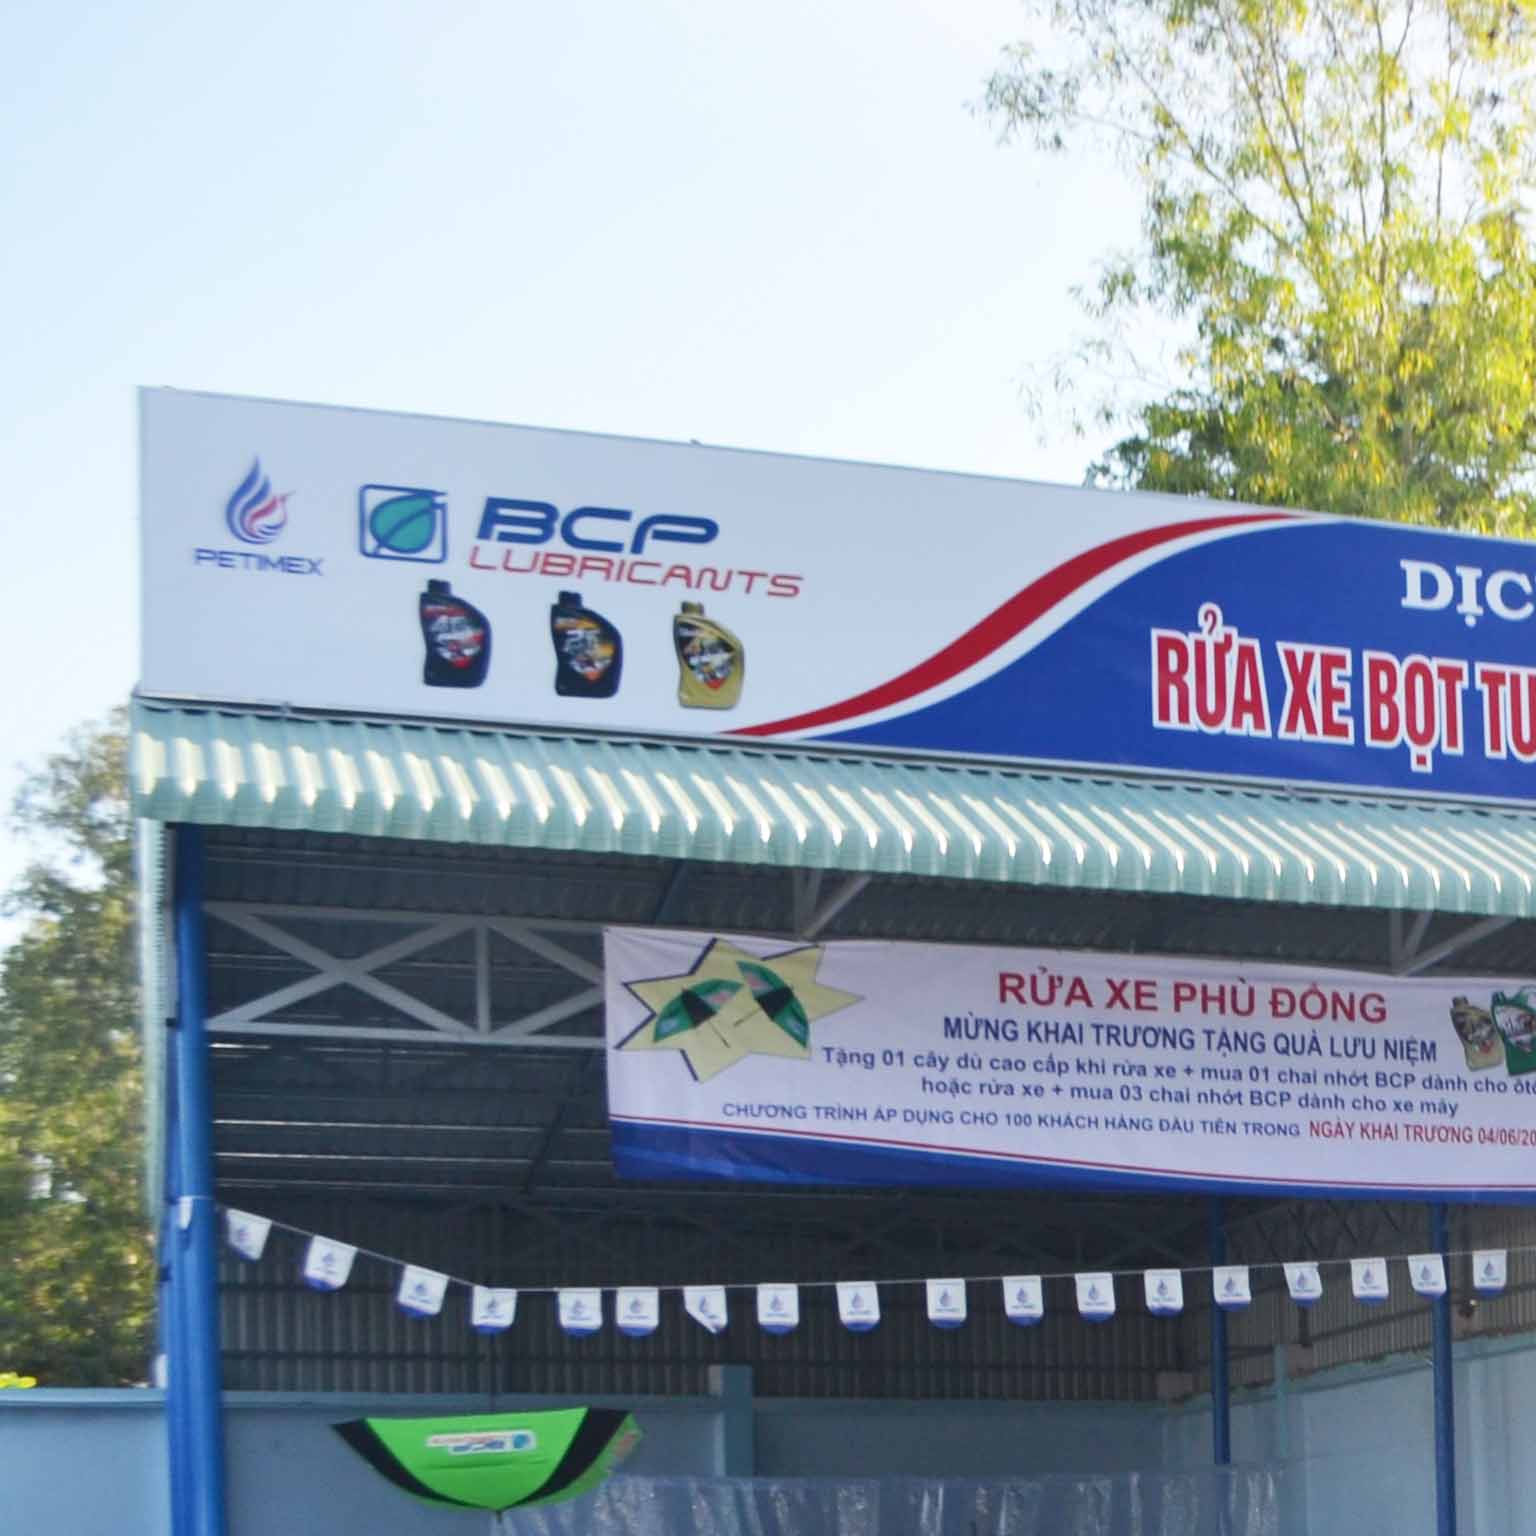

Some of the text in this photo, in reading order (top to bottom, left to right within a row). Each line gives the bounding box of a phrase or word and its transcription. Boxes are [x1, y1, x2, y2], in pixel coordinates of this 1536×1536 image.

[477, 496, 719, 554] BCP
[195, 548, 324, 576] PETIMEX
[469, 546, 803, 599] LUBRICANTS
[1152, 601, 1270, 738] RỬA
[1277, 640, 1353, 744] XE
[1364, 650, 1464, 773] BỌT
[999, 966, 1093, 1007] RỬA
[1106, 978, 1157, 1012] XE
[1173, 978, 1255, 1017] PHÙ
[944, 1012, 1018, 1042] MỪNG
[1027, 1020, 1083, 1045] KHAI
[1091, 1023, 1195, 1050] TRƯƠNG
[1274, 1029, 1322, 1056] QUÀ
[1330, 1038, 1375, 1059] LƯU
[1384, 1037, 1437, 1066] NIỆM
[823, 1047, 875, 1069] Tặng
[882, 1051, 905, 1067] 01
[914, 1053, 949, 1073] cây
[957, 1054, 982, 1071] dù
[990, 1058, 1026, 1073] cao
[1033, 1054, 1070, 1077] cấp
[1077, 1059, 1105, 1075] khi
[1113, 1060, 1147, 1078] rửa
[1154, 1065, 1177, 1078] xe
[1183, 1066, 1194, 1078] +
[1201, 1067, 1242, 1081] mua
[1249, 1066, 1270, 1082] 01
[1277, 1069, 1317, 1086] chai
[1324, 1071, 1368, 1088] nhớt
[1376, 1073, 1416, 1089] BCP
[1422, 1075, 1467, 1092] dành
[1474, 1077, 1508, 1094] cho
[921, 1077, 1459, 1118] hoặc rửa xe + mua 03 chai nhớt BCP dành cho xe máy
[722, 1103, 807, 1120] CHƯƠNG
[903, 1108, 954, 1127] DỤNG
[960, 1111, 998, 1126] CHO
[1005, 1112, 1032, 1127] 100
[1200, 1119, 1238, 1136] TIÊN
[1243, 1122, 1300, 1138] TRONG
[1310, 1116, 1354, 1139] NGÀY
[1360, 1122, 1398, 1141] KHAI
[1405, 1123, 1473, 1144] TRƯƠNG
